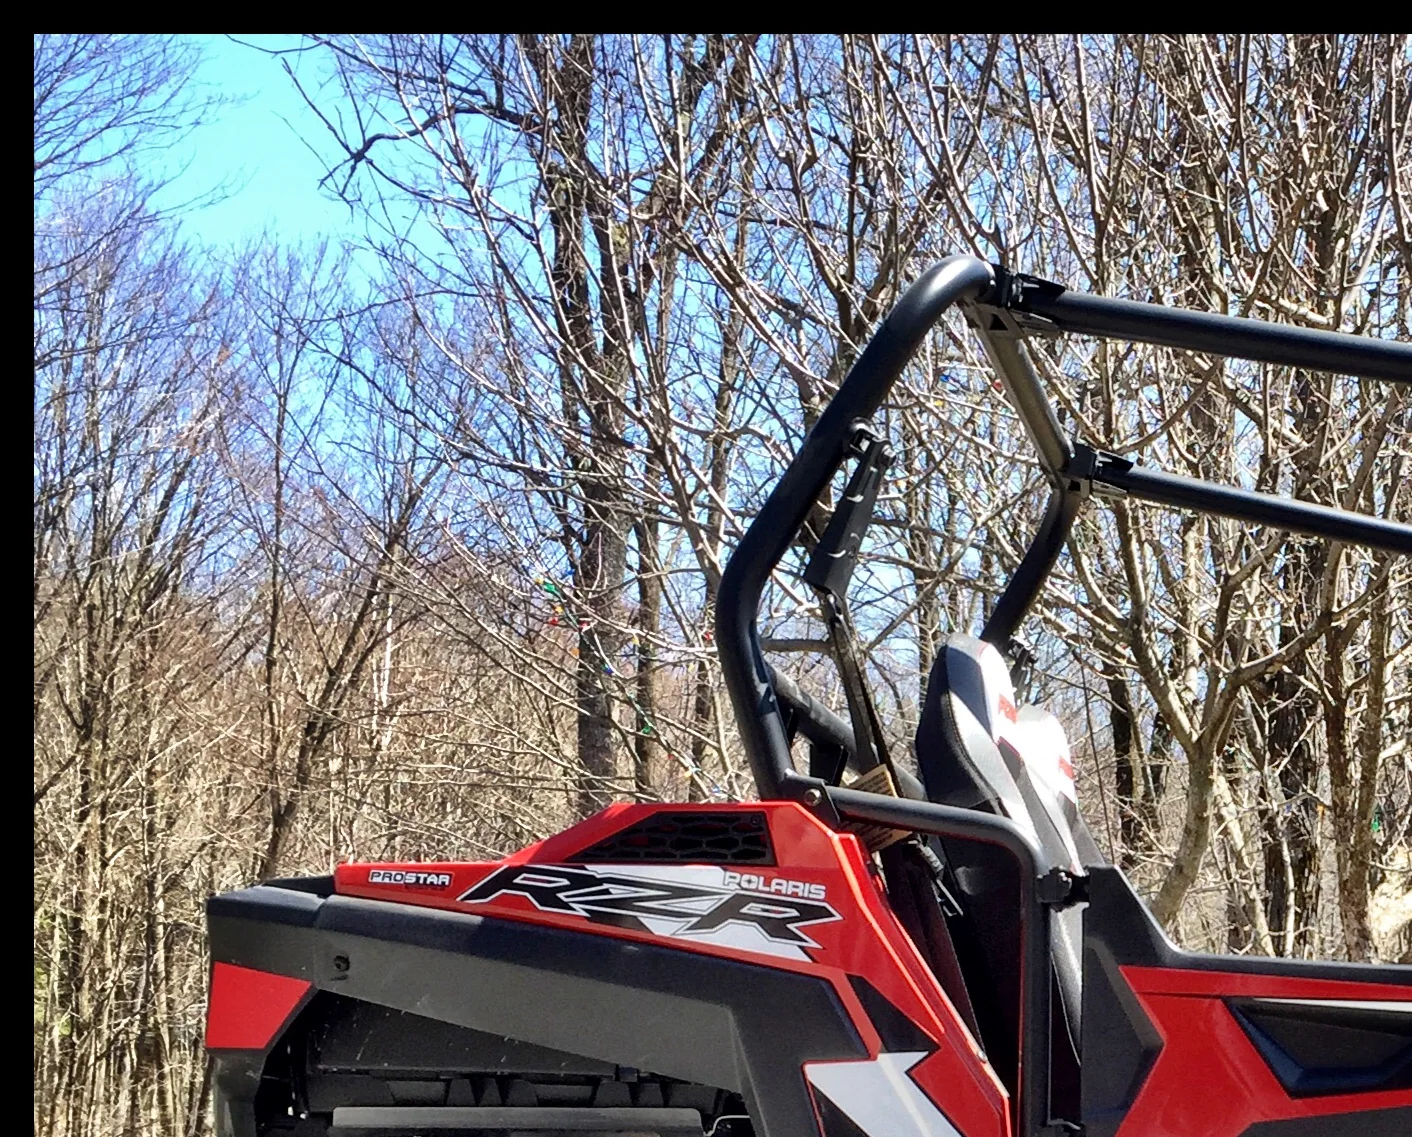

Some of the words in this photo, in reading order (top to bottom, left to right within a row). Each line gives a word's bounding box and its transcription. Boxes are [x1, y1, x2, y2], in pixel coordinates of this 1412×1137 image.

[370, 871, 451, 886] PROSTAR
[722, 870, 826, 900] POLARIS
[457, 864, 844, 949] RZR
